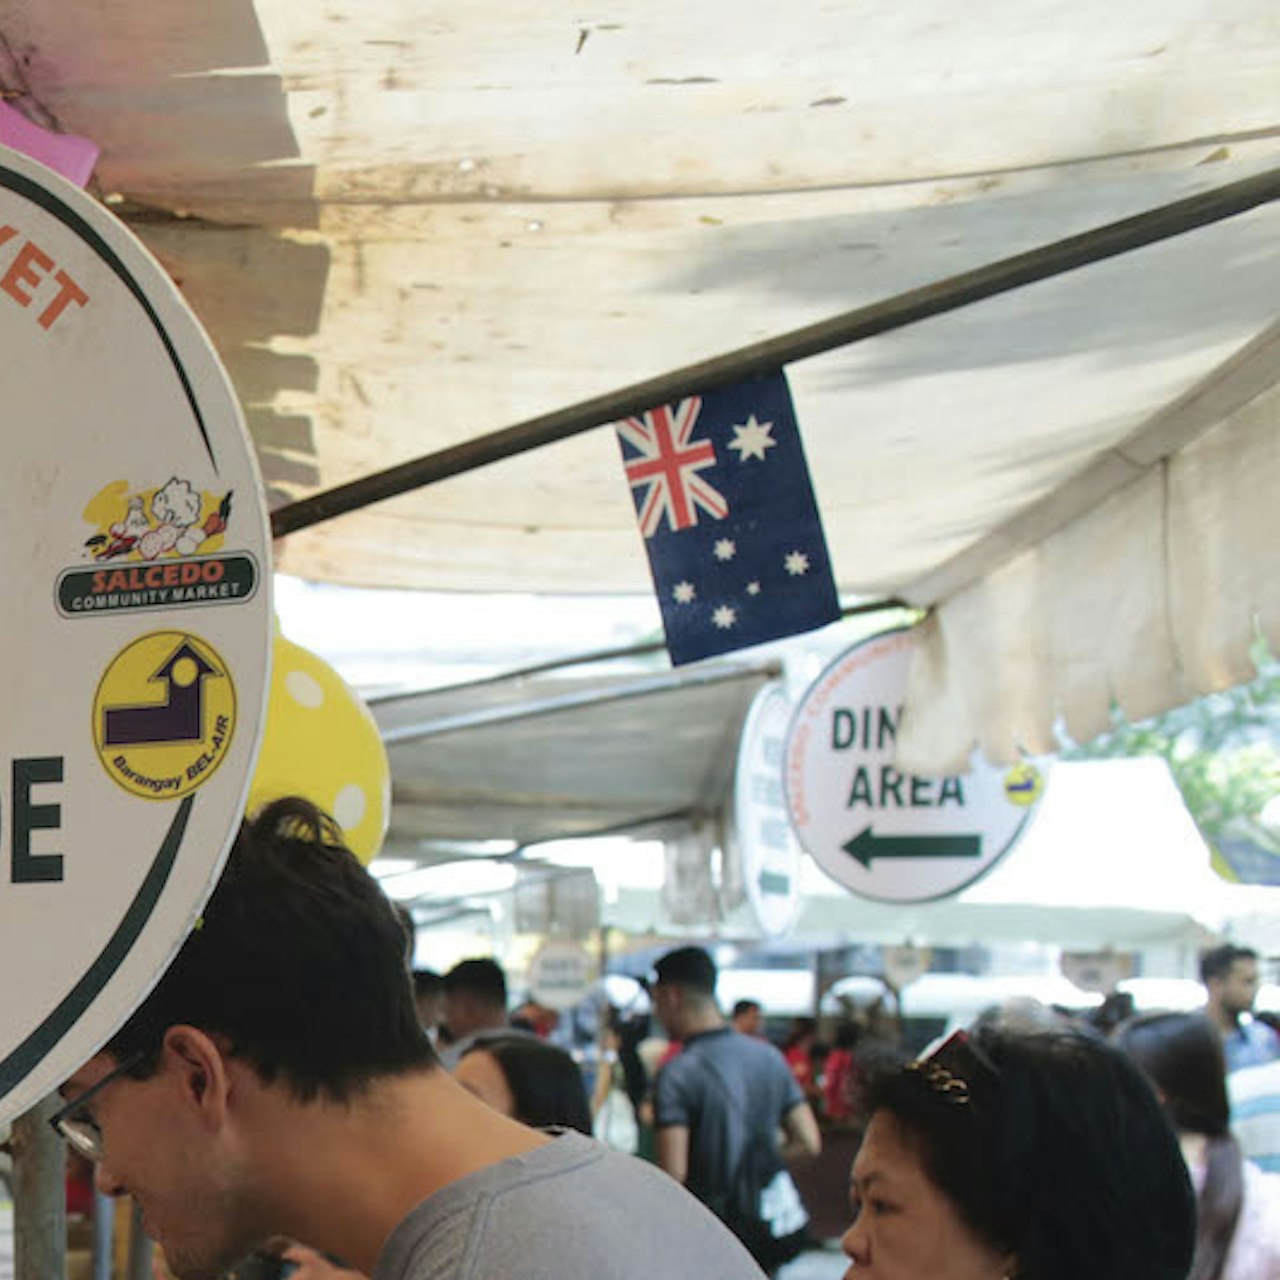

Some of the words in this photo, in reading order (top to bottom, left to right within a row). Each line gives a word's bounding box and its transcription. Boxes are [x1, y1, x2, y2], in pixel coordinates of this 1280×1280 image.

[71, 588, 168, 611] COMMUNITY
[172, 581, 240, 602] MARKET
[92, 560, 225, 593] SALCEDO
[831, 705, 907, 751] DIN
[113, 755, 182, 793] Barangay
[185, 714, 229, 781] BEL-AIR
[846, 765, 965, 809] AREA
